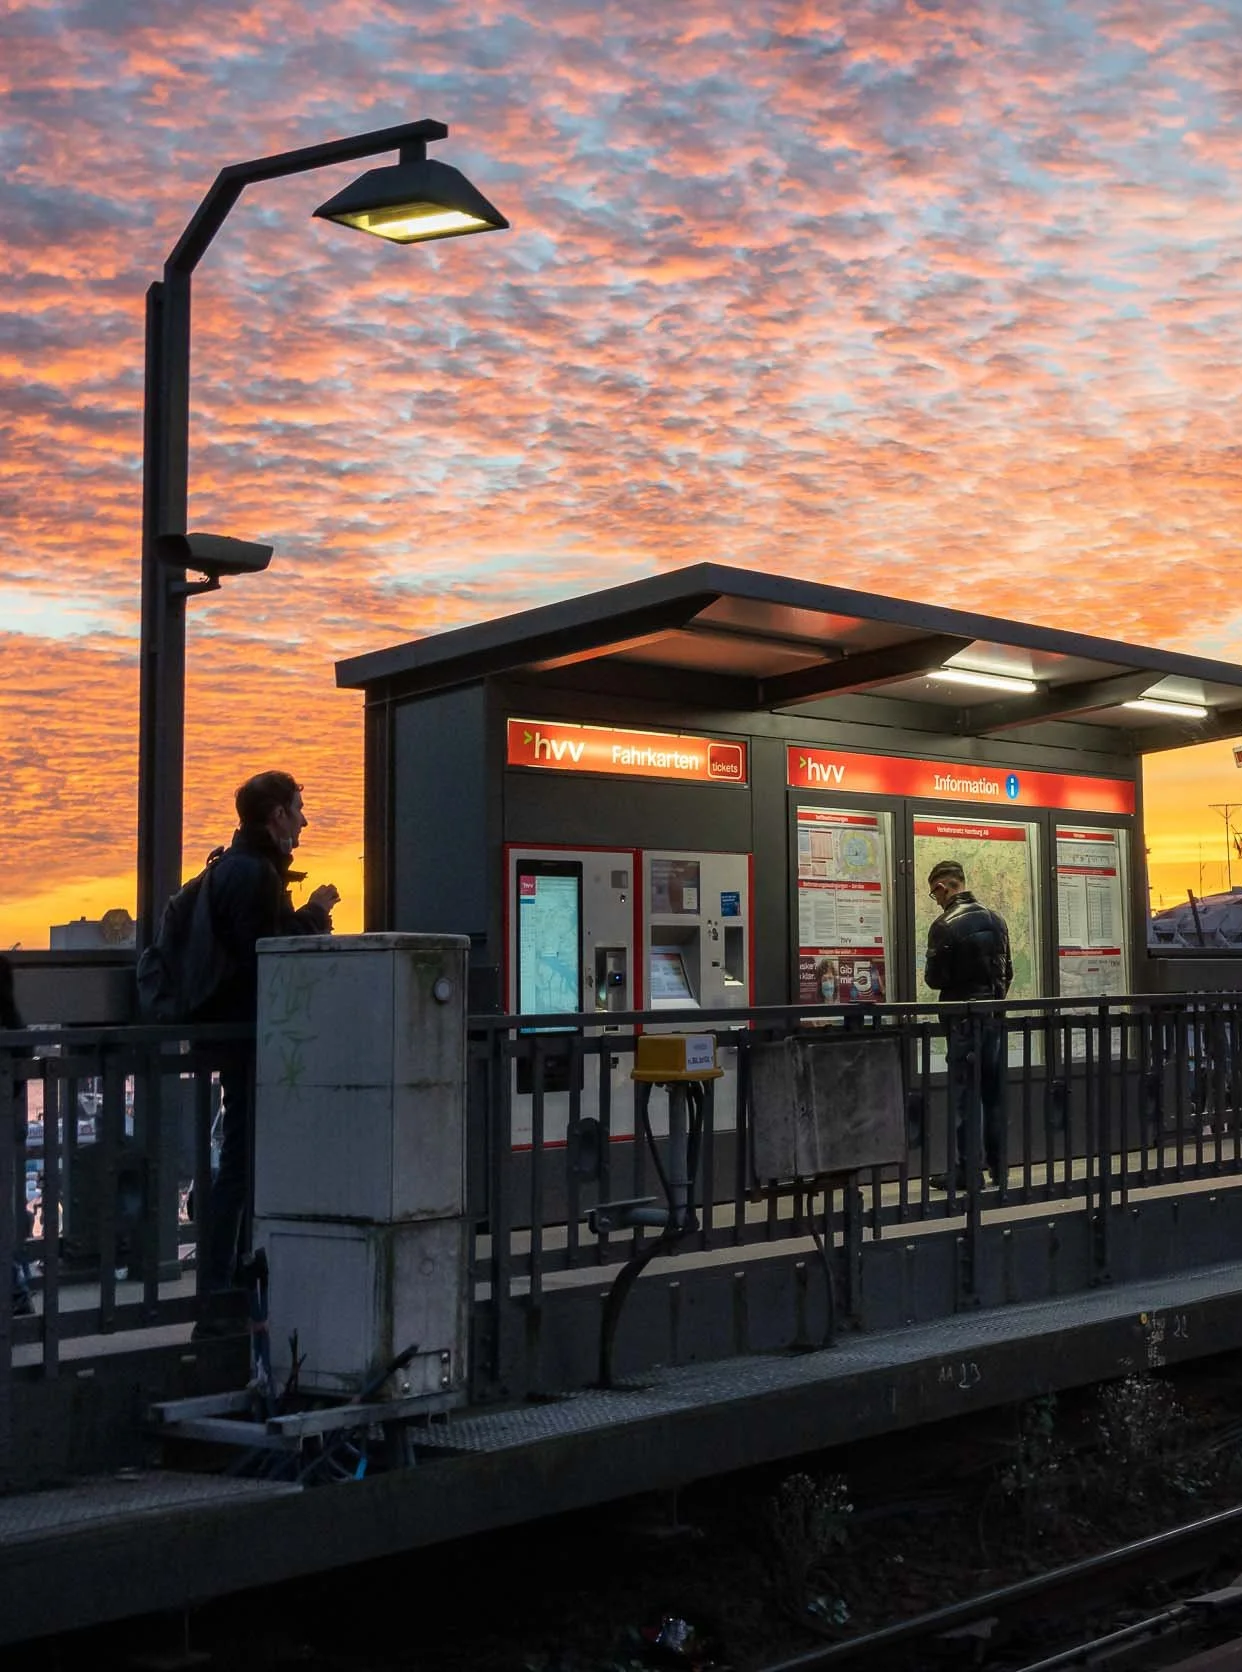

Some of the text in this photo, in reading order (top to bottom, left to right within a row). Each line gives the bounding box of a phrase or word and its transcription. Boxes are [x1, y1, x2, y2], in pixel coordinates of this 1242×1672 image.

[611, 746, 700, 771] Fahrkarten
[711, 761, 739, 774] tickets
[934, 774, 1000, 796] Information
[840, 964, 853, 975] Gib
[853, 961, 872, 992] 5
